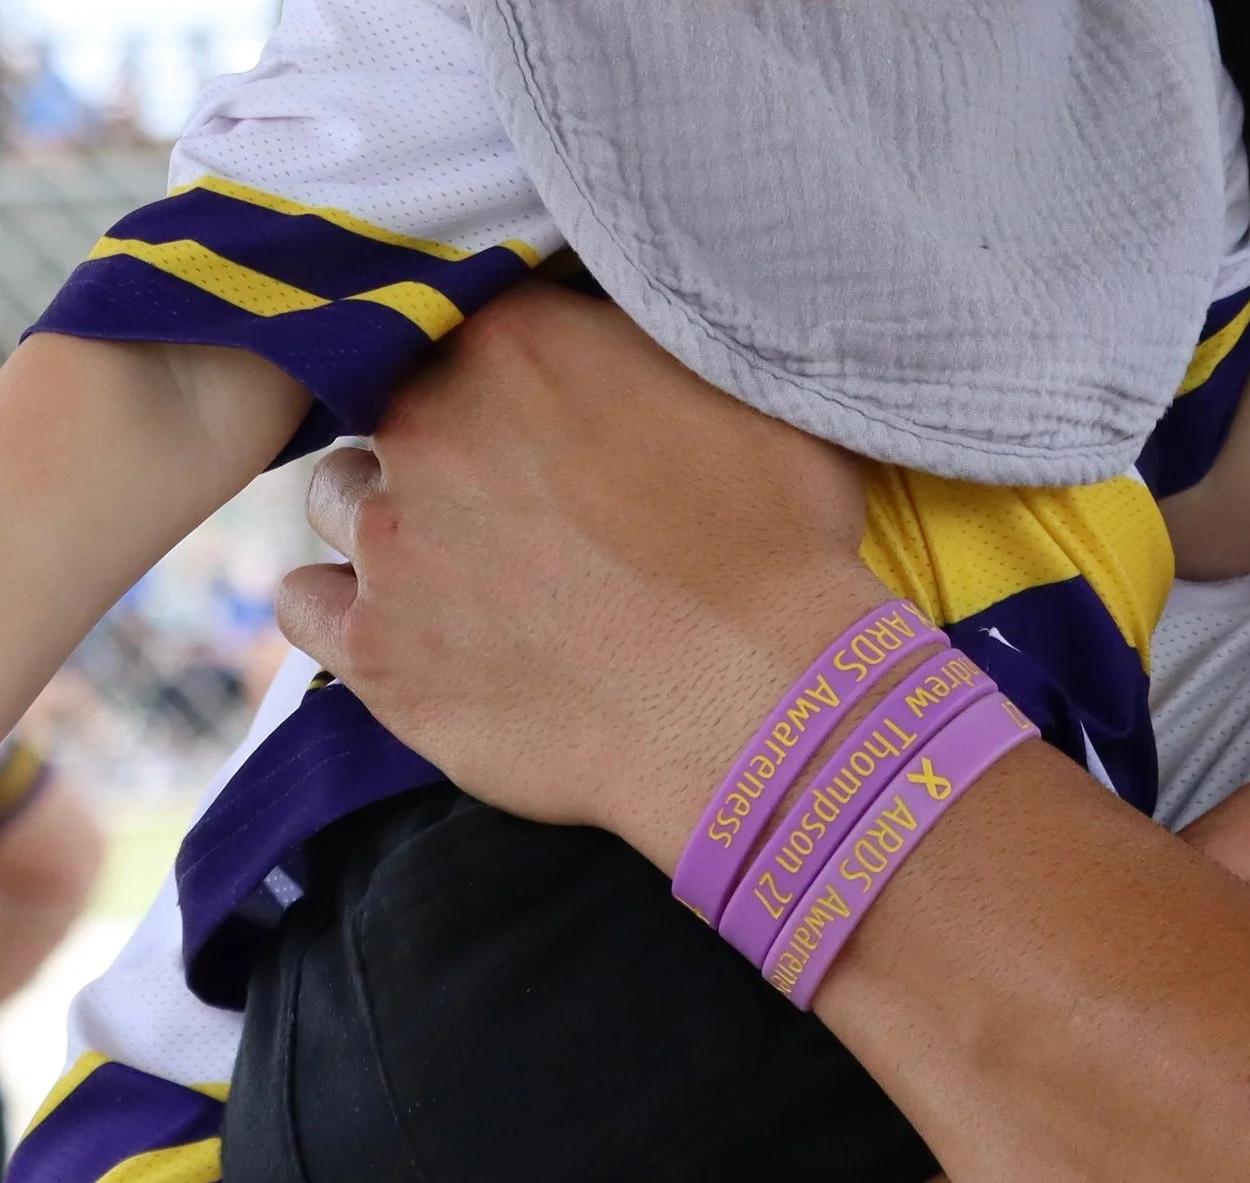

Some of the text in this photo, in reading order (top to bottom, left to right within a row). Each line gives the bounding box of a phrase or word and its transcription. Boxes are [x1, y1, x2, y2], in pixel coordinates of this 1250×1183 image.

[707, 610, 916, 849] ARDS Awareness
[774, 717, 919, 873] Thompson
[839, 794, 919, 893] ARDS
[753, 871, 794, 921] 27
